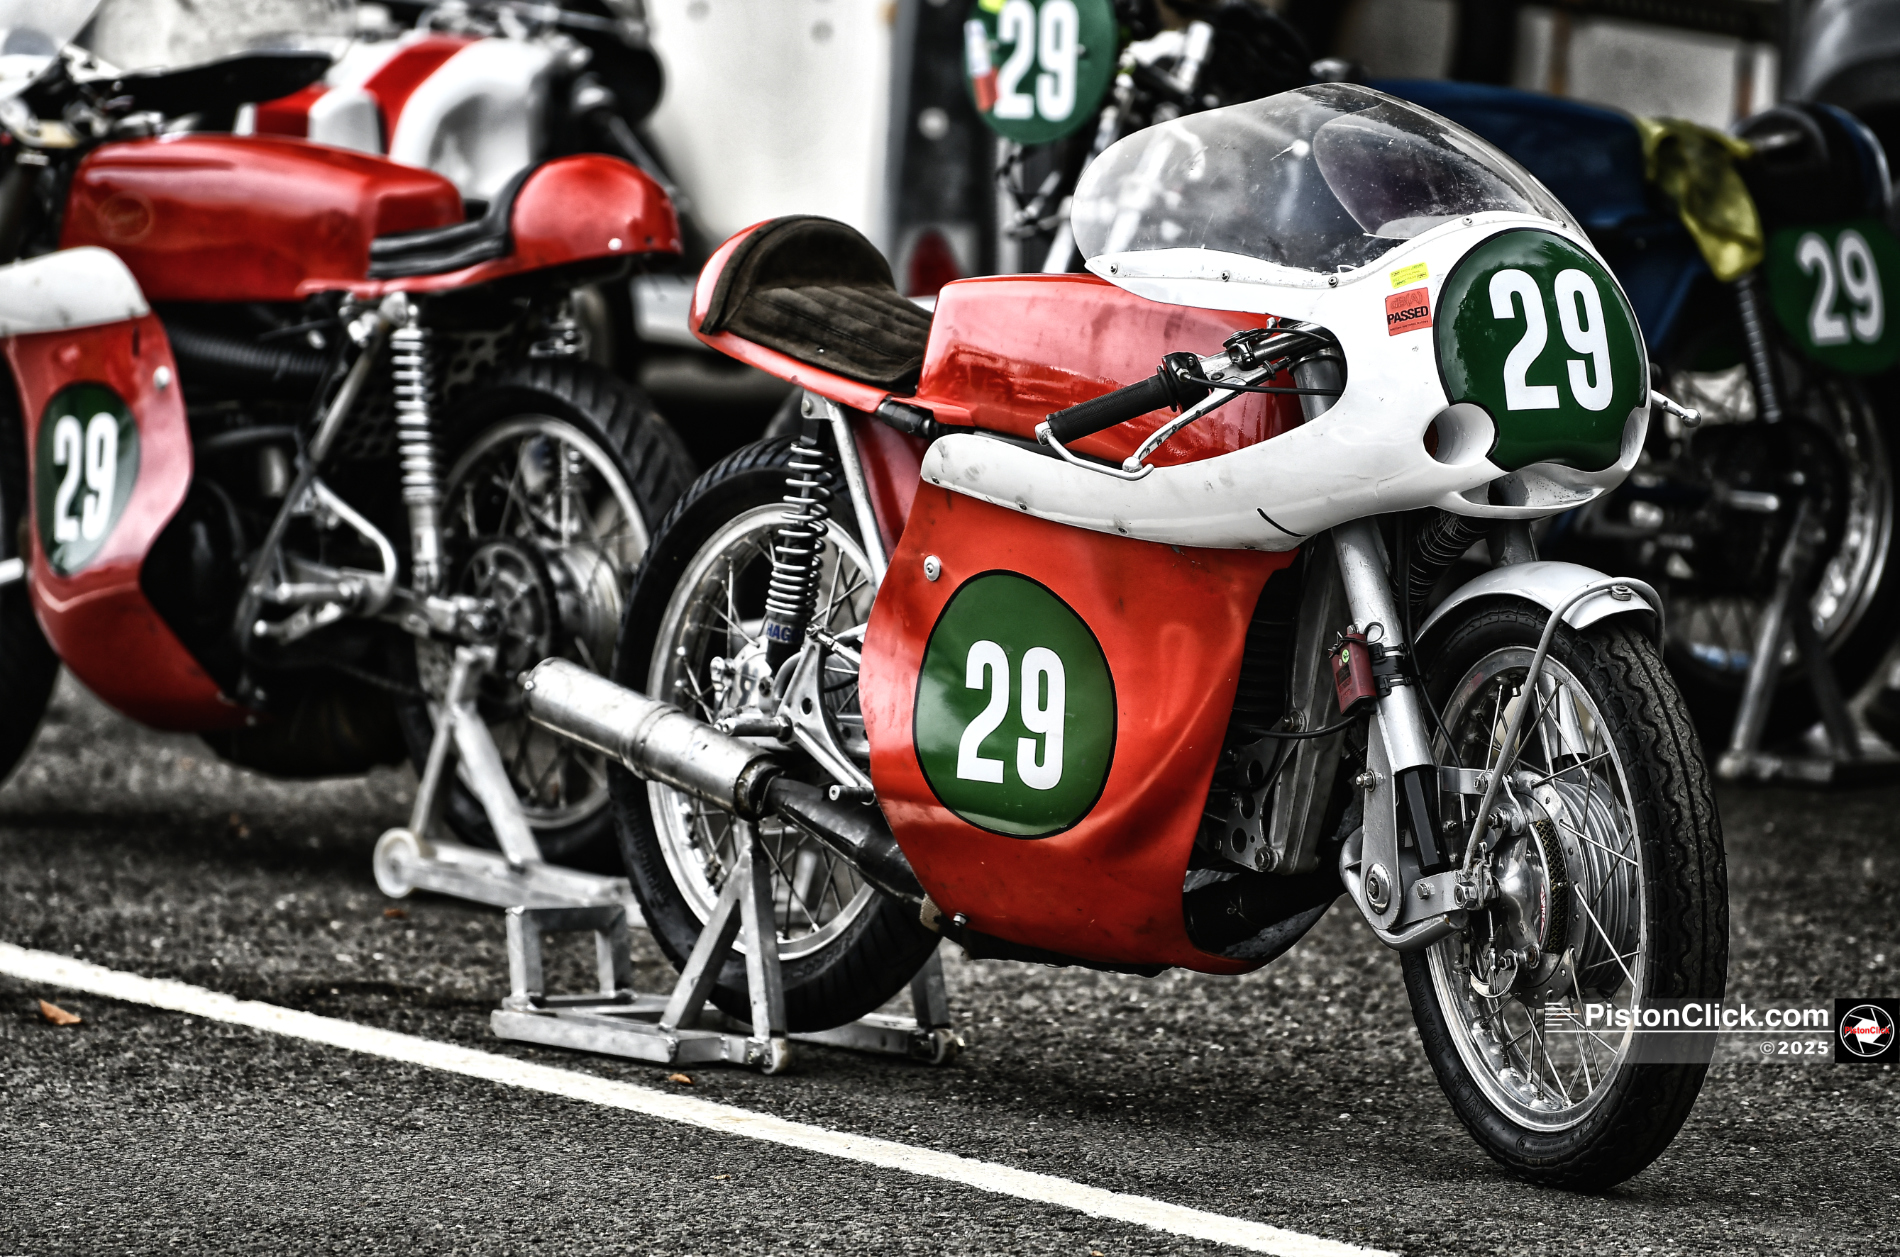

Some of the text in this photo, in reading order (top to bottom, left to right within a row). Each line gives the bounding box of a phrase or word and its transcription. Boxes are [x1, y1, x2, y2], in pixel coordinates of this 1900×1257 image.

[993, 0, 1079, 121] 29
[1387, 306, 1429, 325] PASSED
[1489, 269, 1613, 411] 29
[1796, 229, 1884, 345] 29
[53, 412, 119, 542] 29
[956, 640, 1066, 790] 29
